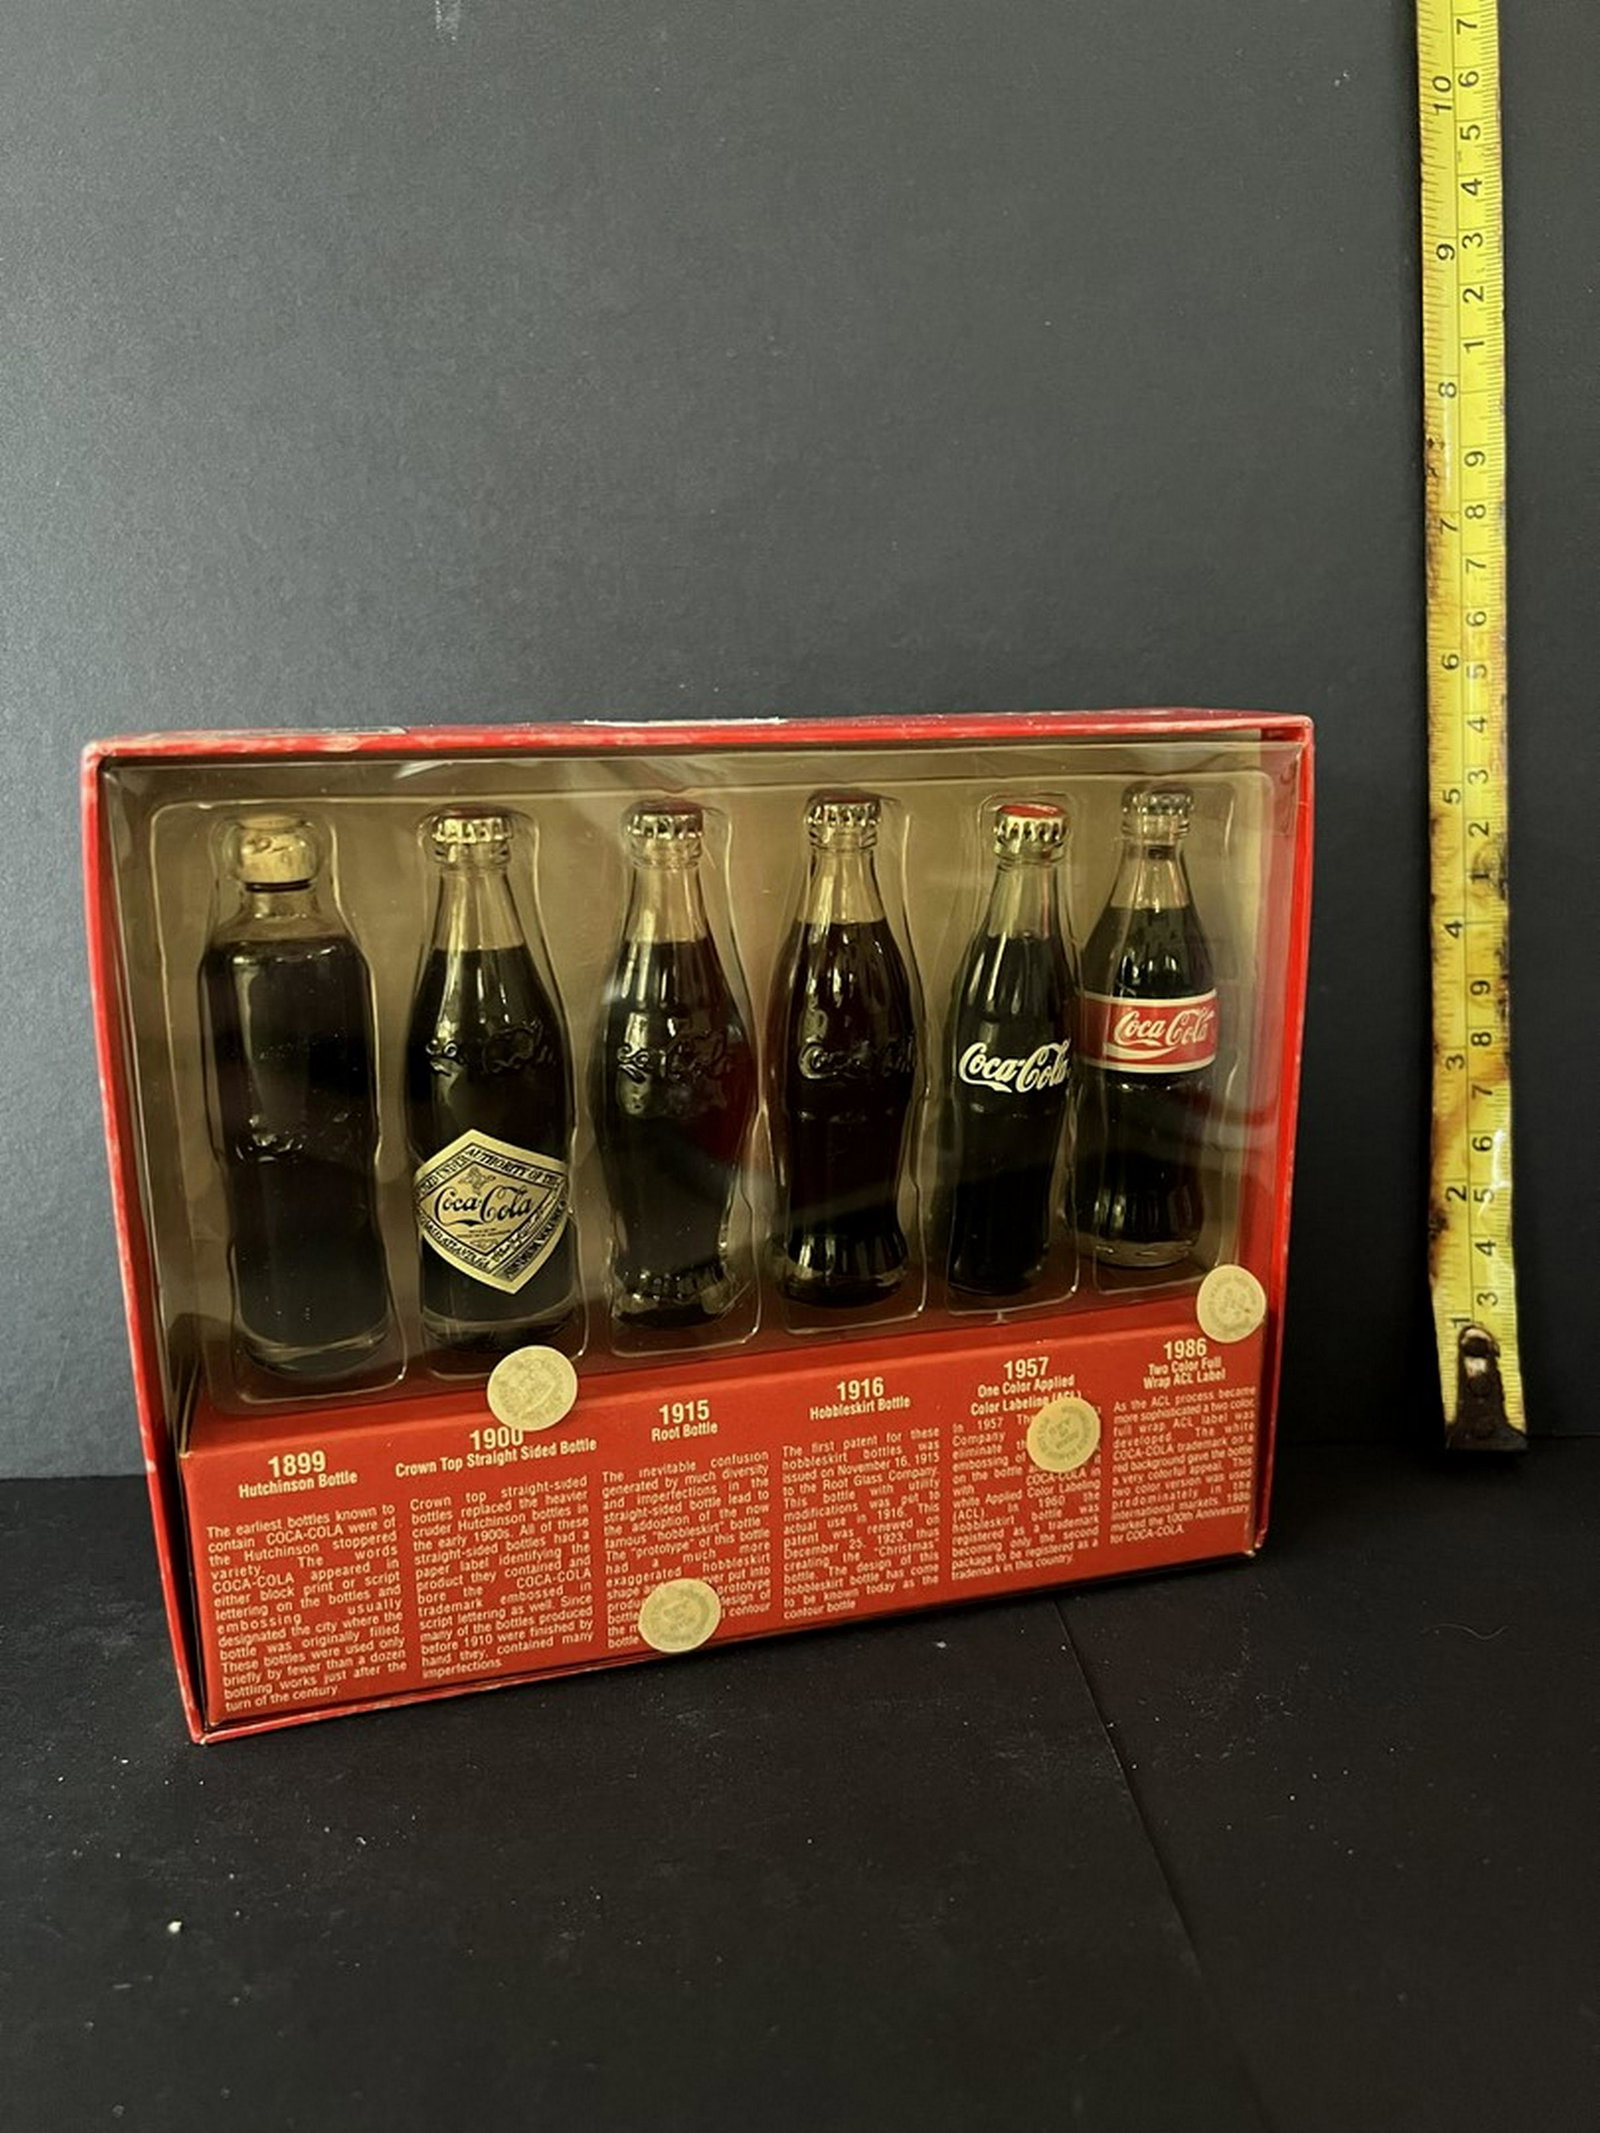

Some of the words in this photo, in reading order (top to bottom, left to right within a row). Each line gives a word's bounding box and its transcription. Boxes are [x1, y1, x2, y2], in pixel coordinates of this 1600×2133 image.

[1457, 19, 1478, 34] 7
[1459, 71, 1479, 87] 6
[1433, 75, 1452, 112] 10
[1460, 125, 1480, 140] 5
[1462, 179, 1482, 195] 4
[1462, 233, 1483, 248] 3
[1437, 244, 1455, 260] 9
[1463, 286, 1484, 302] 2
[1464, 339, 1484, 352] 1
[1438, 382, 1456, 398] 8
[1465, 451, 1485, 467] 9
[1465, 504, 1486, 519] 8
[1440, 519, 1458, 534] 7
[1466, 559, 1486, 573] 7
[1467, 611, 1486, 626] 6
[1442, 654, 1459, 669] 6
[1467, 664, 1488, 679] 5
[1468, 717, 1488, 732] 4
[1468, 769, 1489, 784] 3
[1443, 789, 1460, 804] 5
[1468, 822, 1488, 837] 2
[1444, 920, 1462, 938] 4
[1470, 980, 1490, 995] 9
[1471, 1032, 1492, 1047] 8
[1446, 1055, 1464, 1070] 3
[1472, 1084, 1493, 1098] 7
[1473, 1136, 1493, 1151] 6
[1446, 1186, 1466, 1201] 2
[1474, 1191, 1495, 1204] 5
[1475, 1241, 1496, 1256] 4
[1477, 1292, 1498, 1306] 3
[1164, 1338, 1207, 1360] 1986
[1004, 1357, 1049, 1379] 1957
[1148, 1364, 1168, 1375] Two
[1171, 1359, 1198, 1373] Color
[1201, 1357, 1221, 1369] Full
[978, 1385, 999, 1398] One
[1002, 1381, 1031, 1395] Color
[1034, 1374, 1075, 1392] Applied
[1144, 1376, 1171, 1389] Wrap
[1174, 1373, 1193, 1386] ACL
[1197, 1368, 1225, 1383] Label
[837, 1377, 884, 1401] 1916
[659, 1400, 709, 1425] 1915
[810, 1400, 875, 1420] Hobbleskirt
[878, 1395, 910, 1411] Bottle
[971, 1401, 999, 1415] Color
[1002, 1396, 1049, 1411] Labeling
[1114, 1402, 1126, 1412] As
[1131, 1399, 1146, 1410] the
[1151, 1395, 1170, 1407] ACL
[469, 1426, 523, 1451] 1900
[651, 1426, 680, 1442] Root
[683, 1421, 718, 1438] Bottle
[783, 1445, 802, 1457] The
[812, 1440, 834, 1453] first
[843, 1434, 878, 1453] patent
[887, 1432, 901, 1444] for
[911, 1429, 939, 1440] these
[268, 1451, 326, 1478] 1899
[396, 1461, 437, 1477] Crown
[440, 1457, 463, 1472] Top
[467, 1449, 517, 1468] Straight
[520, 1443, 556, 1459] Sided
[560, 1437, 597, 1455] Bottle
[783, 1451, 847, 1470] hobbleskirt
[863, 1445, 902, 1459] bottles
[918, 1442, 939, 1452] was
[603, 1470, 624, 1482] The
[639, 1460, 696, 1478] inevitable
[711, 1451, 768, 1468] confusion
[783, 1469, 816, 1484] issued
[821, 1469, 834, 1478] on
[838, 1460, 889, 1476] November
[915, 1452, 939, 1466] 1915
[239, 1479, 314, 1498] Hutchinson
[319, 1471, 357, 1487] Bottle
[602, 1478, 658, 1500] generated
[665, 1476, 678, 1491] by
[685, 1470, 716, 1485] much
[722, 1463, 768, 1480] diversity
[410, 1498, 451, 1512] Crown
[466, 1491, 487, 1506] top
[501, 1475, 587, 1499] straight-sided
[604, 1496, 624, 1510] and
[637, 1486, 717, 1507] imperfections
[729, 1481, 739, 1493] in
[752, 1477, 769, 1489] the
[412, 1509, 453, 1525] bottles
[461, 1499, 512, 1520] replaced
[519, 1496, 538, 1509] the
[545, 1489, 587, 1505] heavier
[604, 1501, 681, 1523] straight-sided
[690, 1496, 721, 1511] bottle
[729, 1492, 751, 1505] lead
[758, 1490, 769, 1501] to
[207, 1525, 230, 1539] The
[237, 1517, 282, 1535] earliest
[288, 1512, 330, 1528] bottles
[336, 1507, 377, 1521] known
[383, 1502, 395, 1515] to
[412, 1523, 451, 1538] cruder
[458, 1513, 526, 1531] Hutchinson
[532, 1505, 571, 1520] bottles
[578, 1501, 588, 1514] in
[208, 1536, 255, 1553] contain
[266, 1523, 343, 1545] COCA-COLA
[348, 1521, 378, 1534] were
[383, 1515, 396, 1529] of
[413, 1539, 432, 1552] the
[438, 1533, 467, 1549] early
[520, 1522, 535, 1536] All
[541, 1520, 552, 1533] of
[558, 1517, 589, 1530] these
[210, 1553, 230, 1567] the
[245, 1544, 319, 1562] Hutchinson
[333, 1529, 397, 1551] stoppered
[298, 1554, 323, 1568] The
[355, 1544, 398, 1561] words
[414, 1541, 498, 1565] straight-sided
[506, 1536, 545, 1552] bottles
[554, 1530, 575, 1544] had
[583, 1531, 589, 1540] a
[213, 1571, 294, 1594] COCA-COLA
[311, 1560, 371, 1583] appeared
[387, 1556, 399, 1569] in
[214, 1592, 250, 1607] either
[261, 1584, 294, 1601] block
[304, 1578, 333, 1598] print
[343, 1578, 355, 1589] or
[365, 1568, 400, 1586] script
